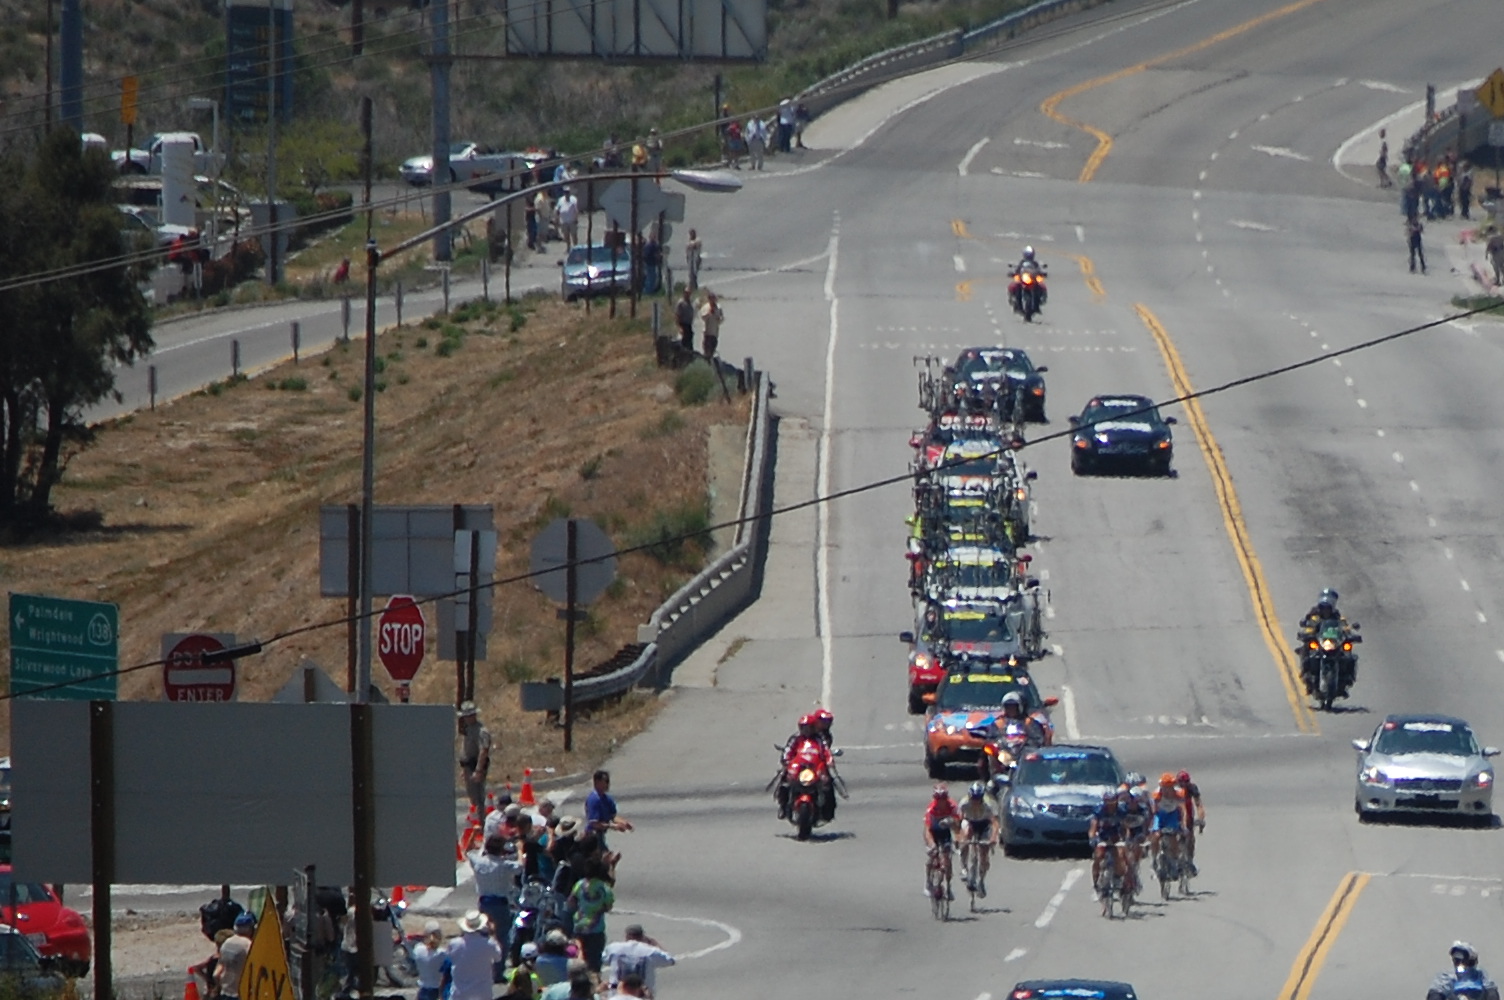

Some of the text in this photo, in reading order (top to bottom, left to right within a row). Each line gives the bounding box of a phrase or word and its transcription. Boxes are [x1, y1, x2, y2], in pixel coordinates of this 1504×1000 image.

[28, 605, 73, 621] Palmdale
[29, 627, 83, 645] Wrightwood
[92, 622, 110, 639] 138
[381, 623, 422, 655] STOP
[173, 651, 193, 666] DO
[15, 657, 93, 678] Silverwood Lake
[177, 688, 224, 703] ENTER
